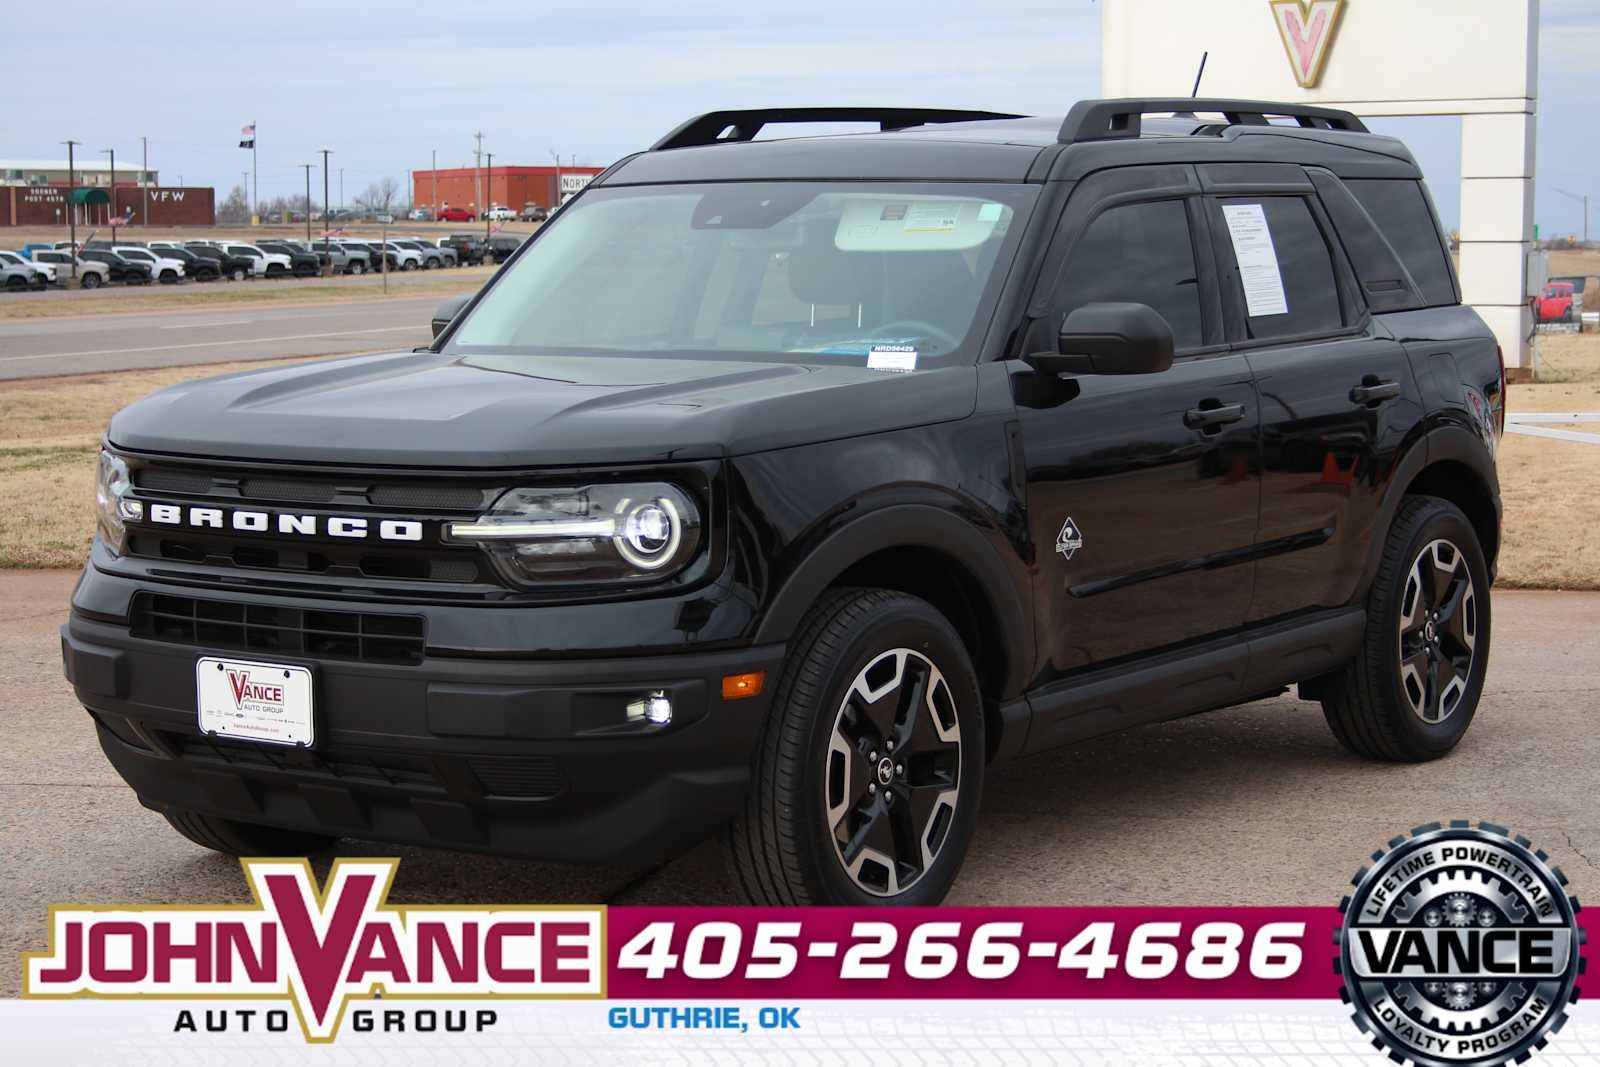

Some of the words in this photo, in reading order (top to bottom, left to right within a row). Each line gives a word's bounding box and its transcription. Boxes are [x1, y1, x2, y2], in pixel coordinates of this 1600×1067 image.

[1270, 0, 1344, 87] V
[150, 190, 185, 201] VFW
[150, 503, 423, 541] BRONCO
[229, 672, 282, 706] VANCE
[244, 704, 260, 713] AUTO
[262, 705, 284, 714] GROUP
